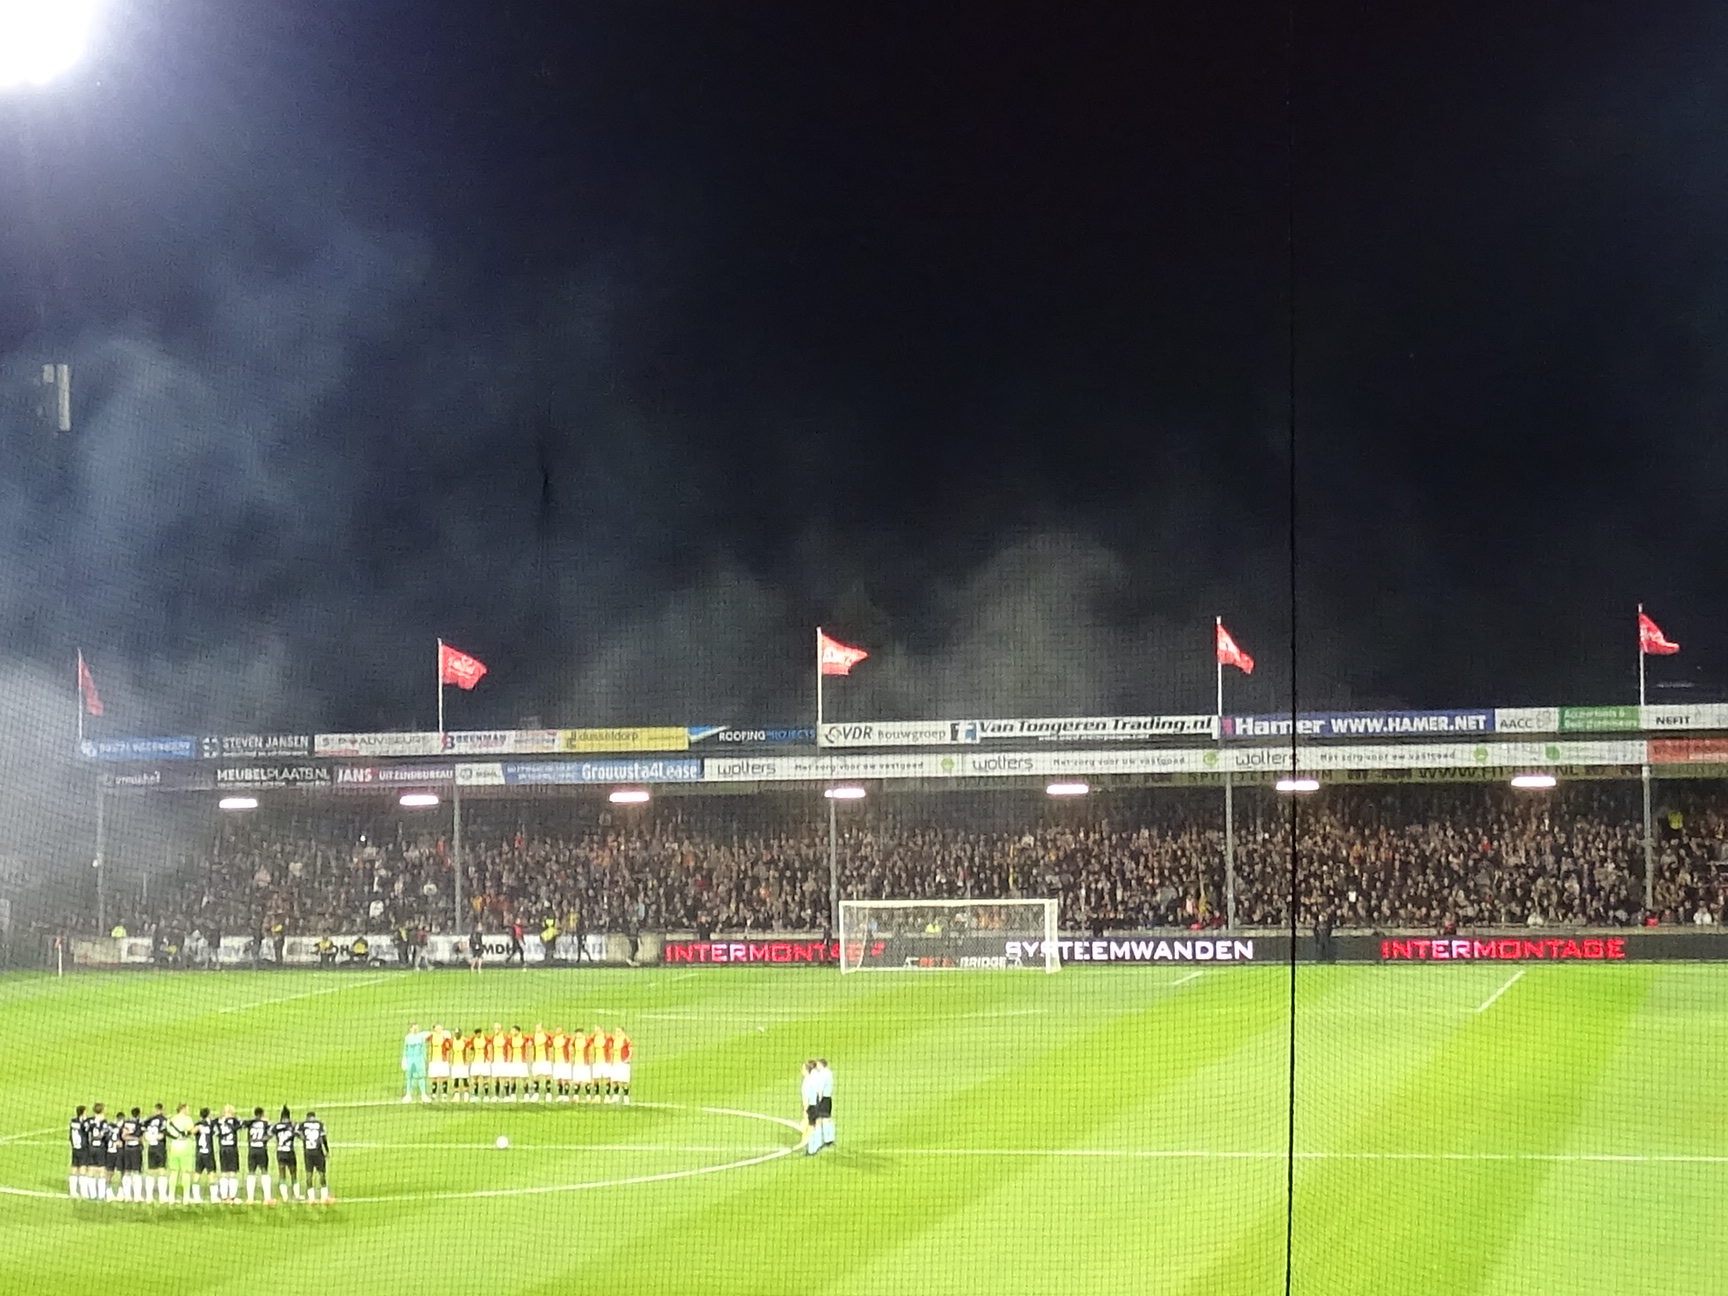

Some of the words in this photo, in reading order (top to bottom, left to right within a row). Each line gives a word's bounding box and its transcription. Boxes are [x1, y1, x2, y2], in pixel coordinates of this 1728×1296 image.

[979, 720, 1014, 733] Van
[1020, 719, 1108, 735] Tongeren
[1112, 716, 1213, 734] Trading.nl
[1236, 716, 1325, 735] Hamer
[1331, 715, 1486, 734] WWW.HAMER.NET
[1500, 718, 1533, 729] AACC
[1656, 716, 1691, 725] NEFIT
[719, 731, 766, 742] ROOFING
[842, 726, 872, 740] VDR
[222, 736, 262, 749] STEVEN
[265, 735, 309, 749] JANSEN
[972, 756, 1034, 771] wolters
[1235, 751, 1300, 767] wolters
[717, 761, 776, 776] wolters
[337, 769, 373, 784] JANS
[1381, 939, 1626, 959] INTERMONTAGE
